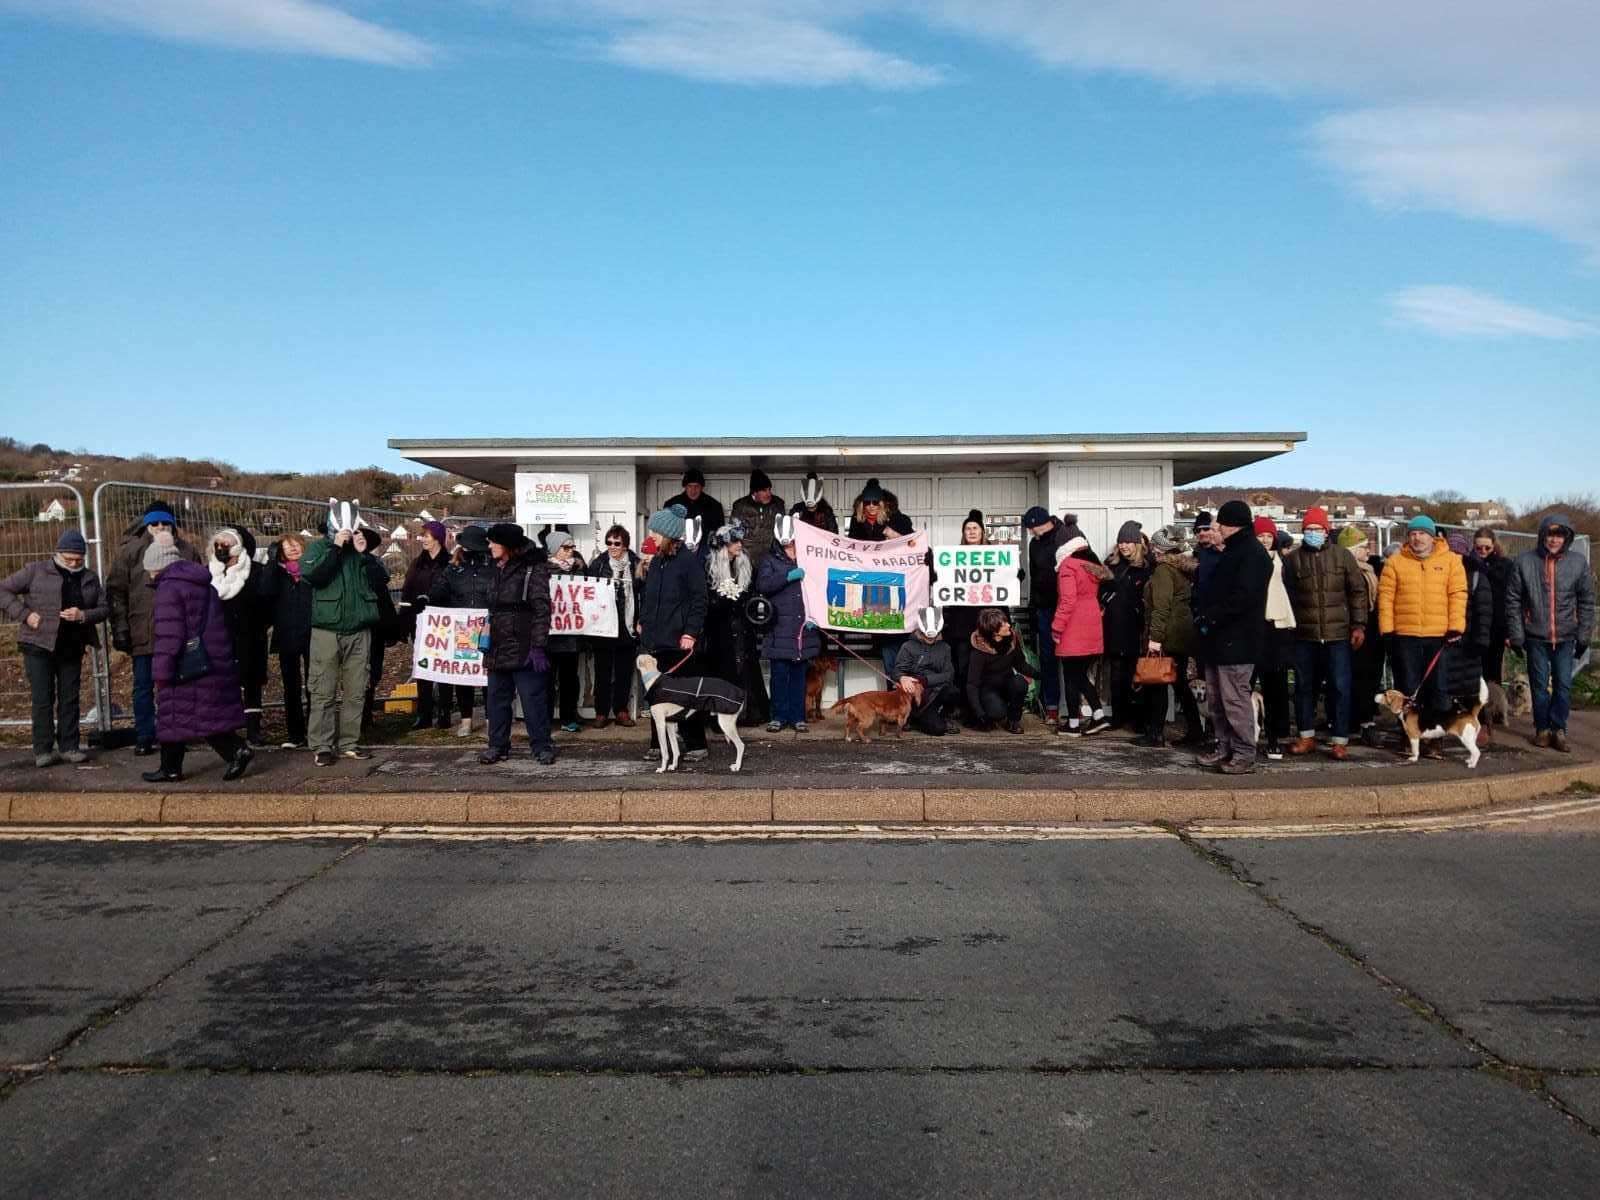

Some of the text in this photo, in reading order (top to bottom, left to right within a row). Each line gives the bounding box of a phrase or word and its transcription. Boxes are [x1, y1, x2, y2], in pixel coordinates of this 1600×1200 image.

[535, 483, 572, 493] SAVE
[831, 537, 884, 552] SAVE
[872, 554, 925, 567] PARADE
[938, 551, 1011, 566] GREEN
[954, 568, 996, 584] NOT
[553, 584, 595, 602] AVE
[427, 614, 486, 628] NO HO
[551, 614, 585, 631] OAD
[425, 633, 449, 650] ON
